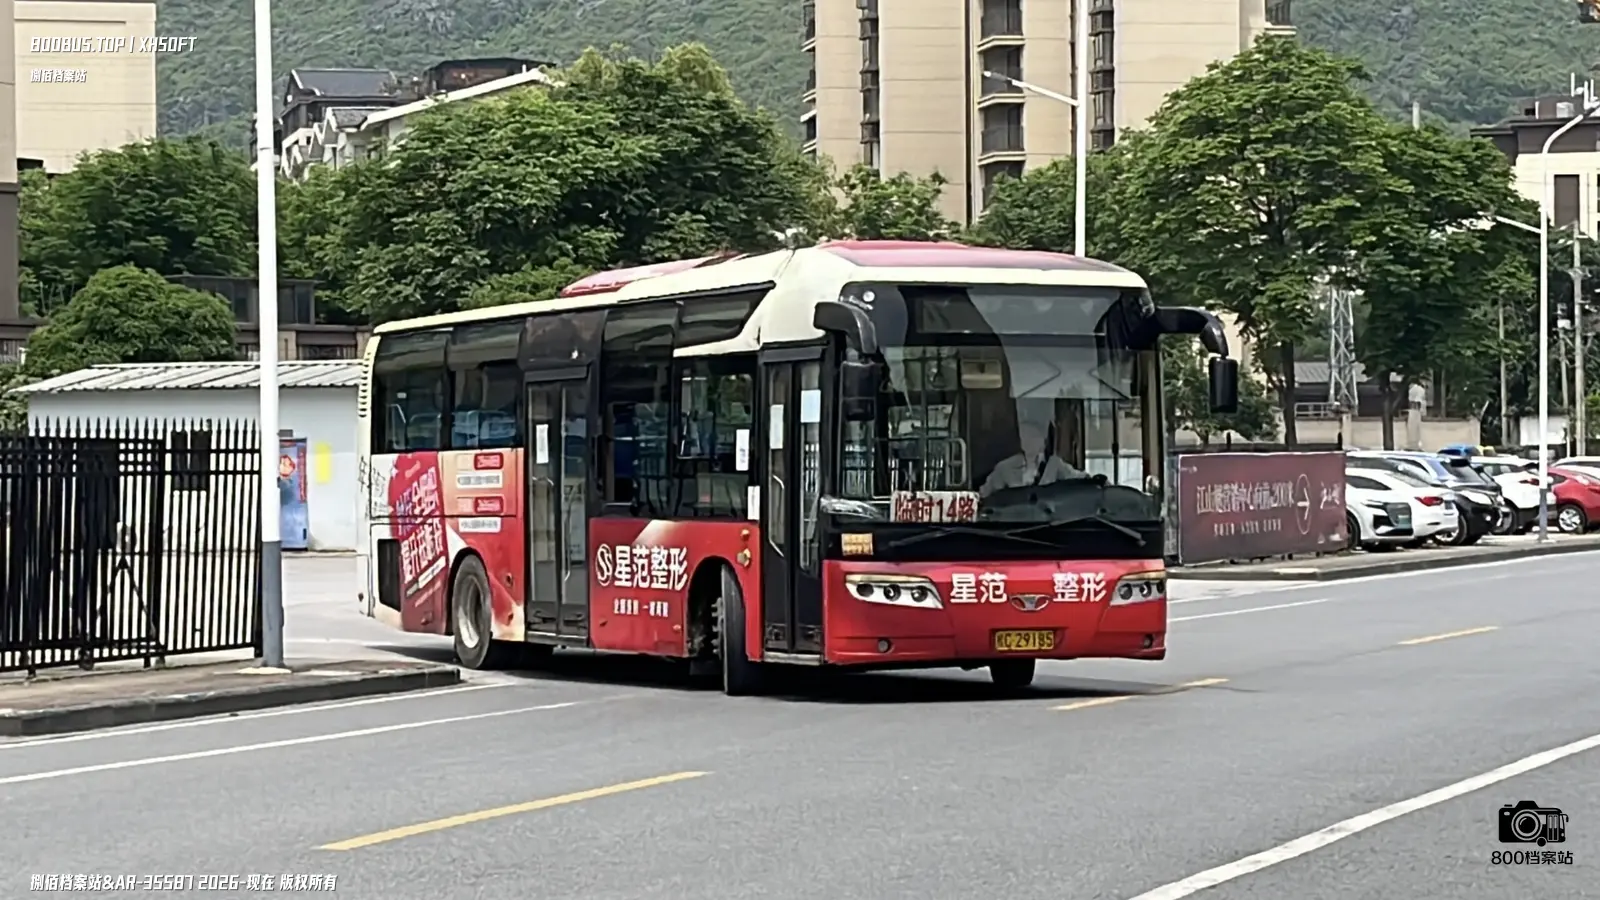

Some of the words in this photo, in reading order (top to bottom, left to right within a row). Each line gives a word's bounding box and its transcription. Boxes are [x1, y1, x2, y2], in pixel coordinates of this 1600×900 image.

[894, 493, 975, 522] 临时14路
[613, 544, 688, 591] 星范整形
[949, 572, 1008, 604] 星范
[1052, 571, 1108, 603] 整形
